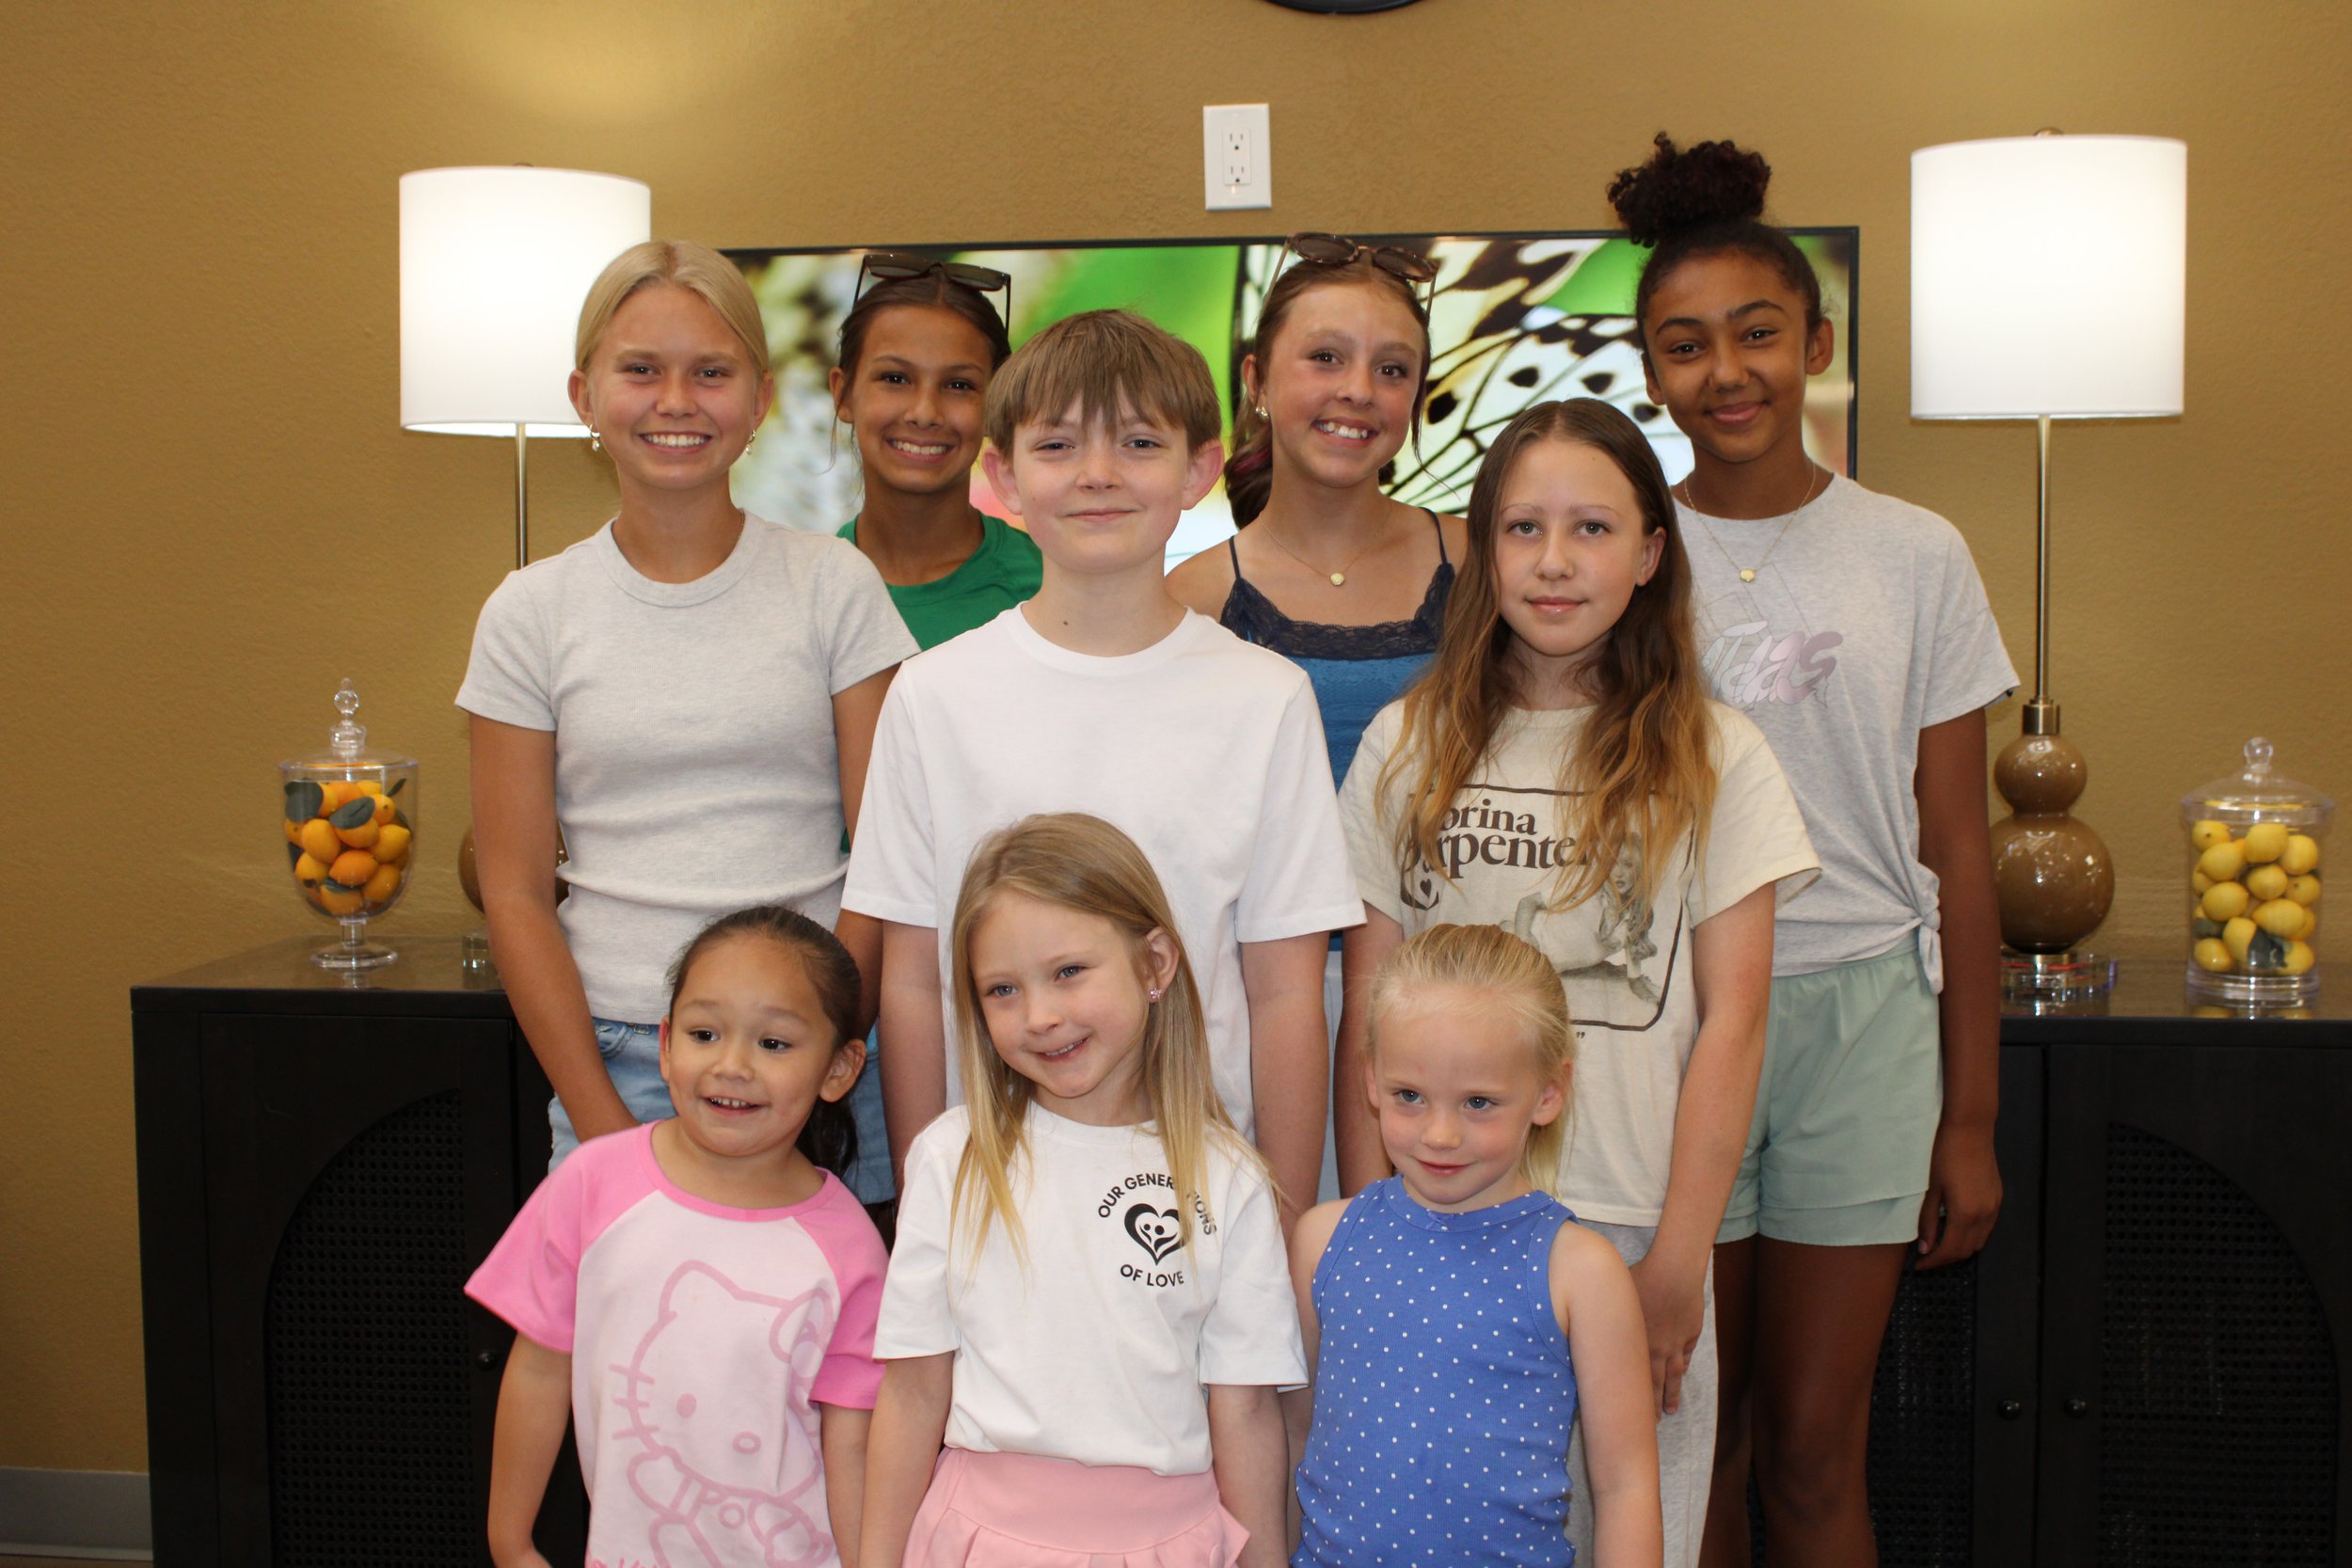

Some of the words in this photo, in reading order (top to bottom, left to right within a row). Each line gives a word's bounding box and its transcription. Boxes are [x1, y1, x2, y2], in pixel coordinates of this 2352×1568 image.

[1440, 799, 1537, 835] rina
[1405, 832, 1589, 879] rpente
[1098, 1185, 1125, 1218] OUR
[1120, 1264, 1143, 1281] OF
[1147, 1271, 1184, 1287] LOVE
